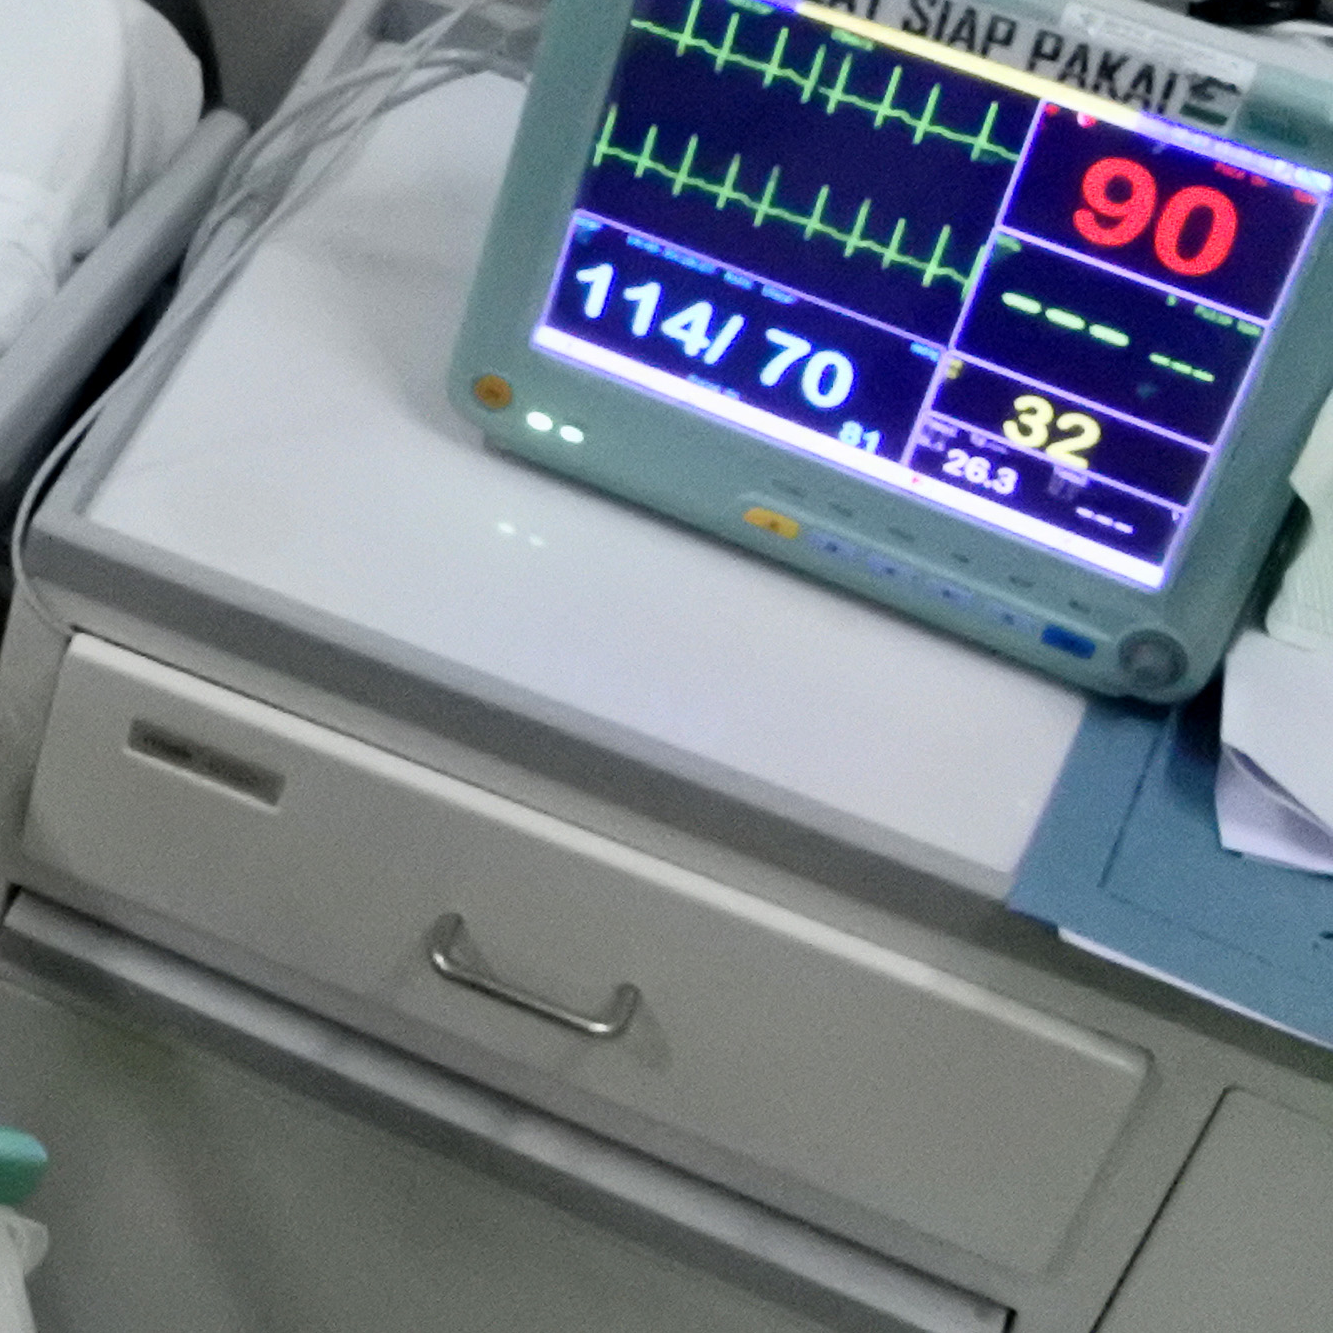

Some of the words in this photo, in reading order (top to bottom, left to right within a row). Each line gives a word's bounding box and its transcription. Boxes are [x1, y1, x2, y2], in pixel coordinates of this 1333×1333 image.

[1026, 28, 1179, 114] PAKAI
[1072, 156, 1238, 276] 90
[575, 262, 746, 365] 114/
[760, 328, 854, 408] 70
[838, 421, 880, 454] 81
[941, 448, 1020, 495] 26.3
[1003, 395, 1101, 469] 32
